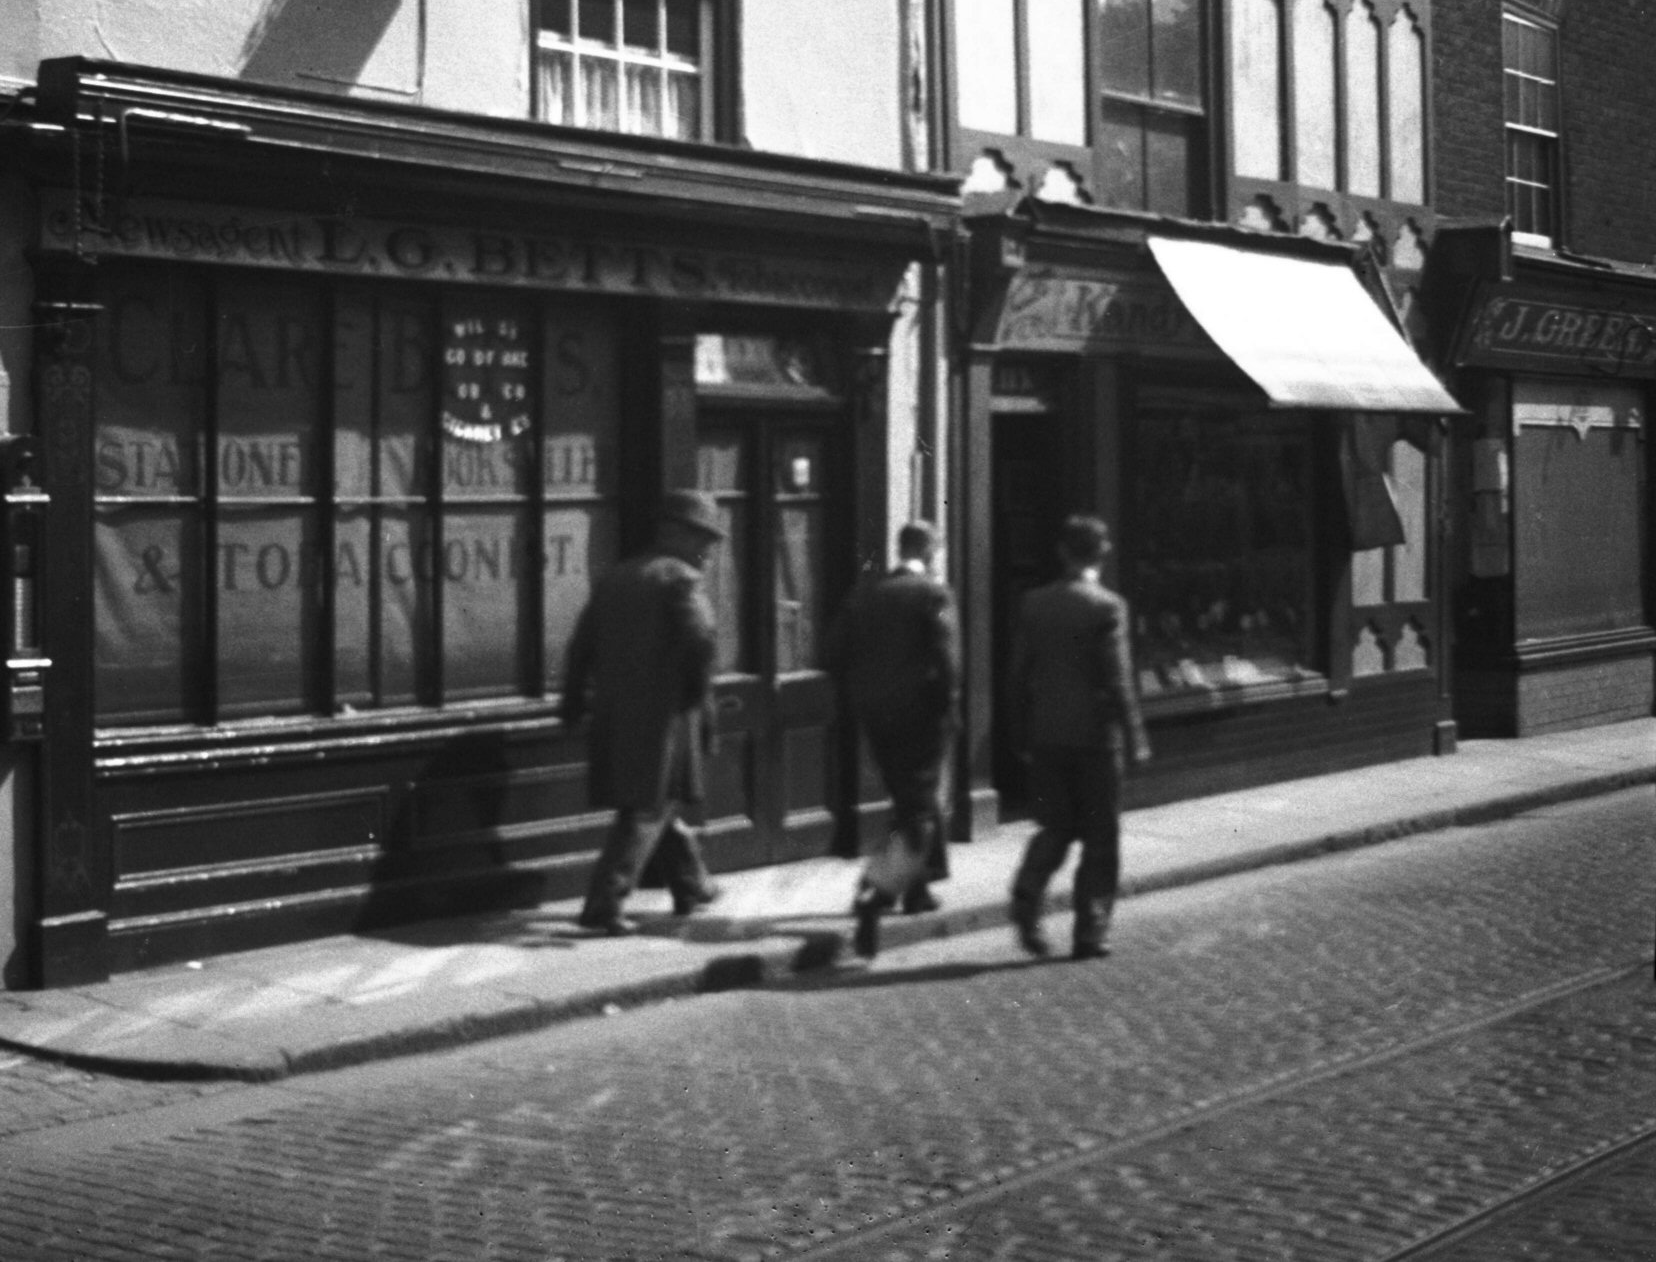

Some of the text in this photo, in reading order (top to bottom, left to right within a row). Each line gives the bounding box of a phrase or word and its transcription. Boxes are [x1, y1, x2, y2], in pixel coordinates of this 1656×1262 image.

[50, 196, 304, 261] Newsagent
[98, 439, 303, 491] STAONE
[134, 535, 582, 595] & TOACCONIT.
